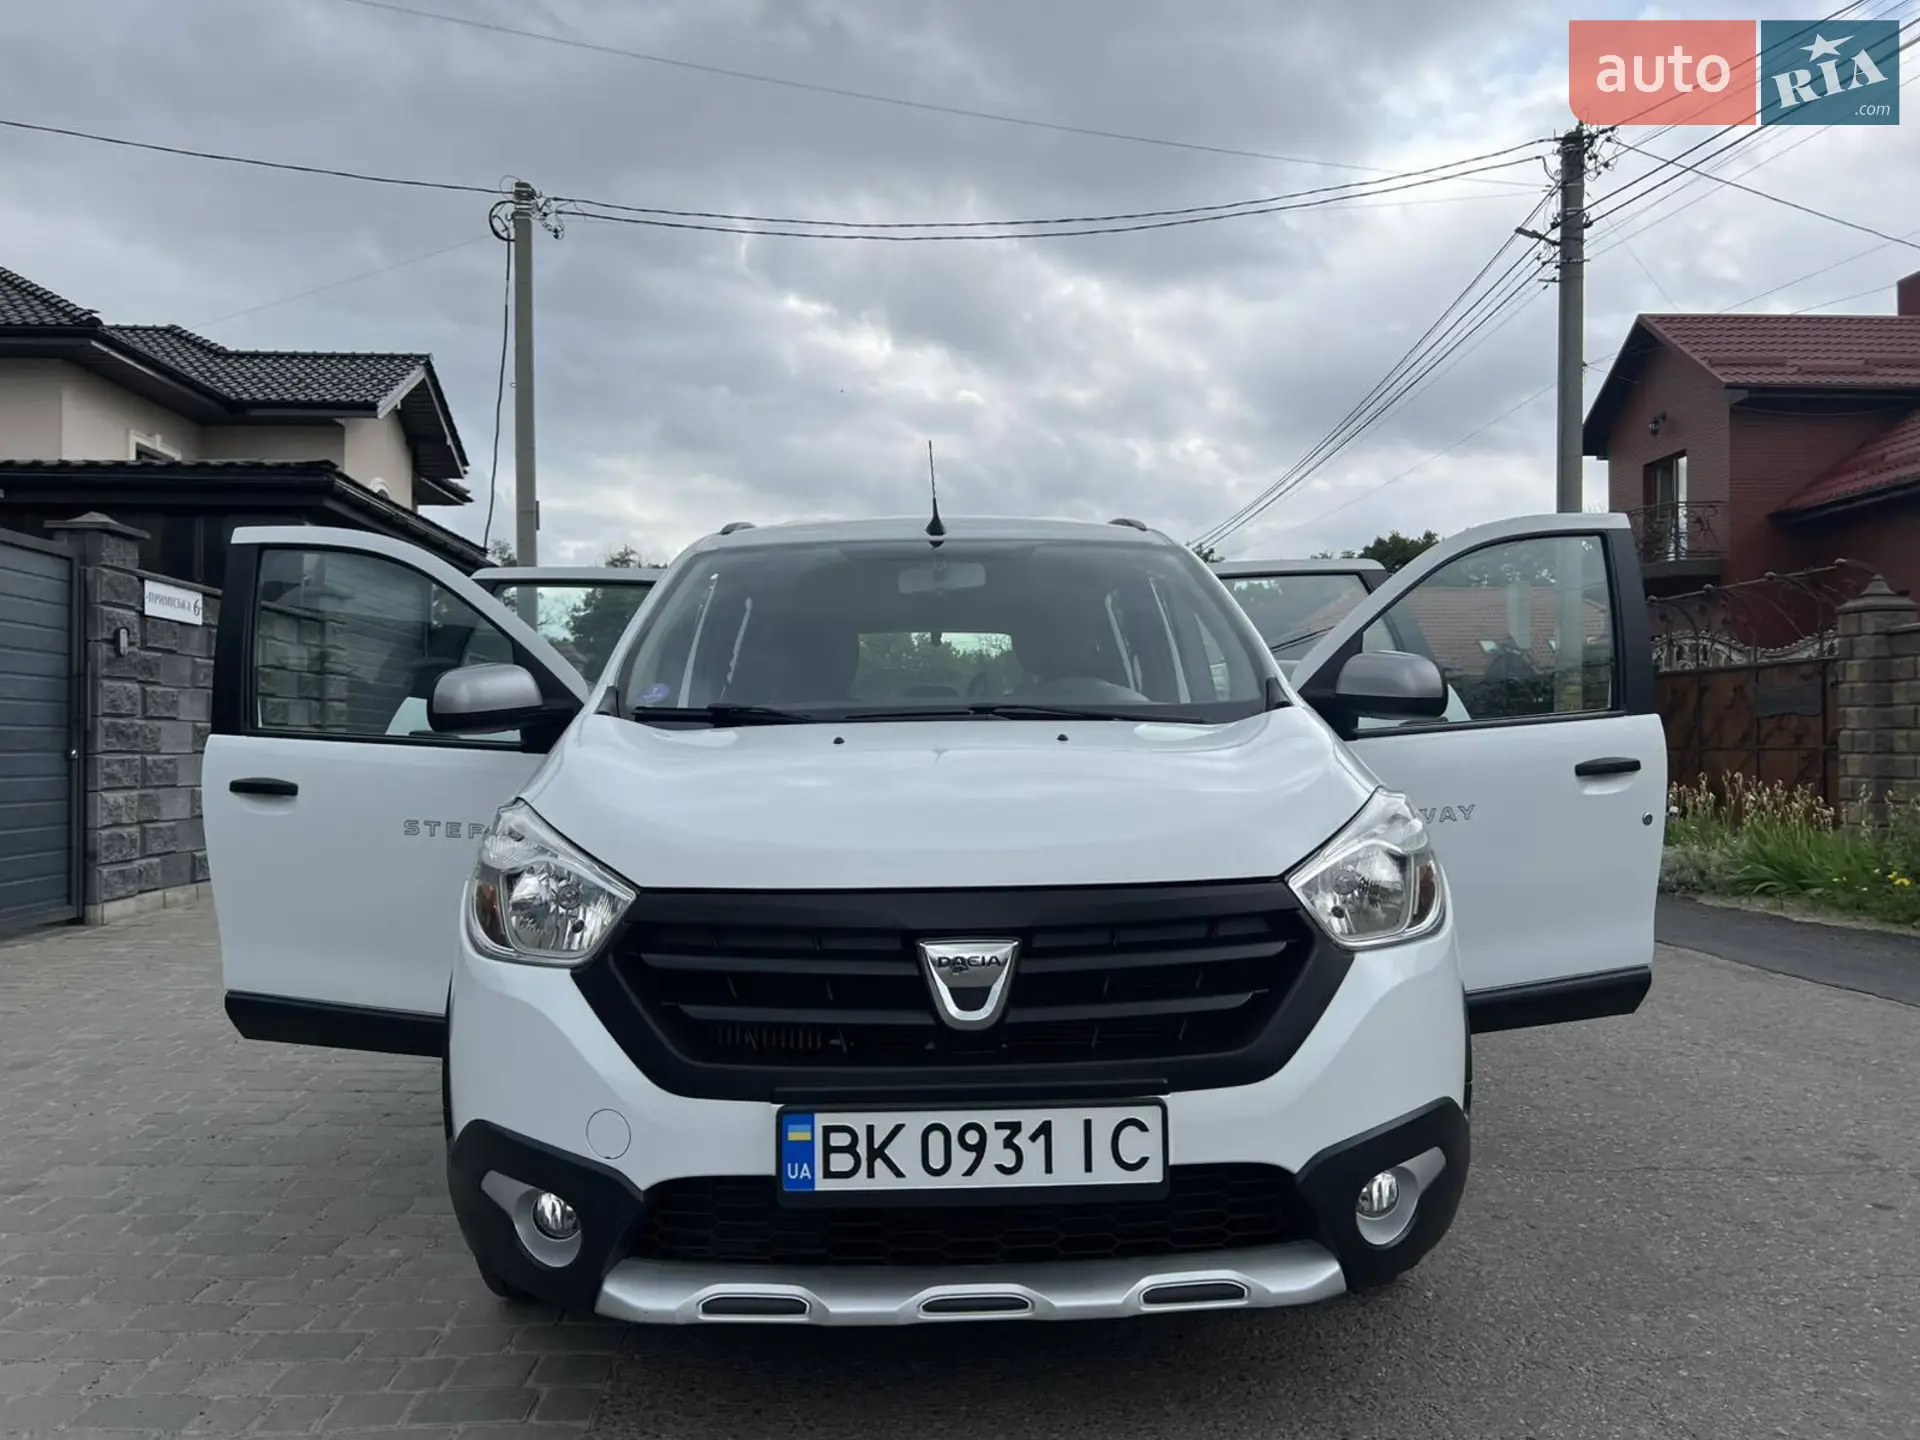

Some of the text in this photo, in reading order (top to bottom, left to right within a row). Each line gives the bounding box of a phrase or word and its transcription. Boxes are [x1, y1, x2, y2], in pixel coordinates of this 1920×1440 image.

[193, 598, 201, 617] 6
[937, 955, 1002, 968] DACIA
[821, 1117, 1151, 1180] BK 0931 IC
[787, 1162, 812, 1180] UA
